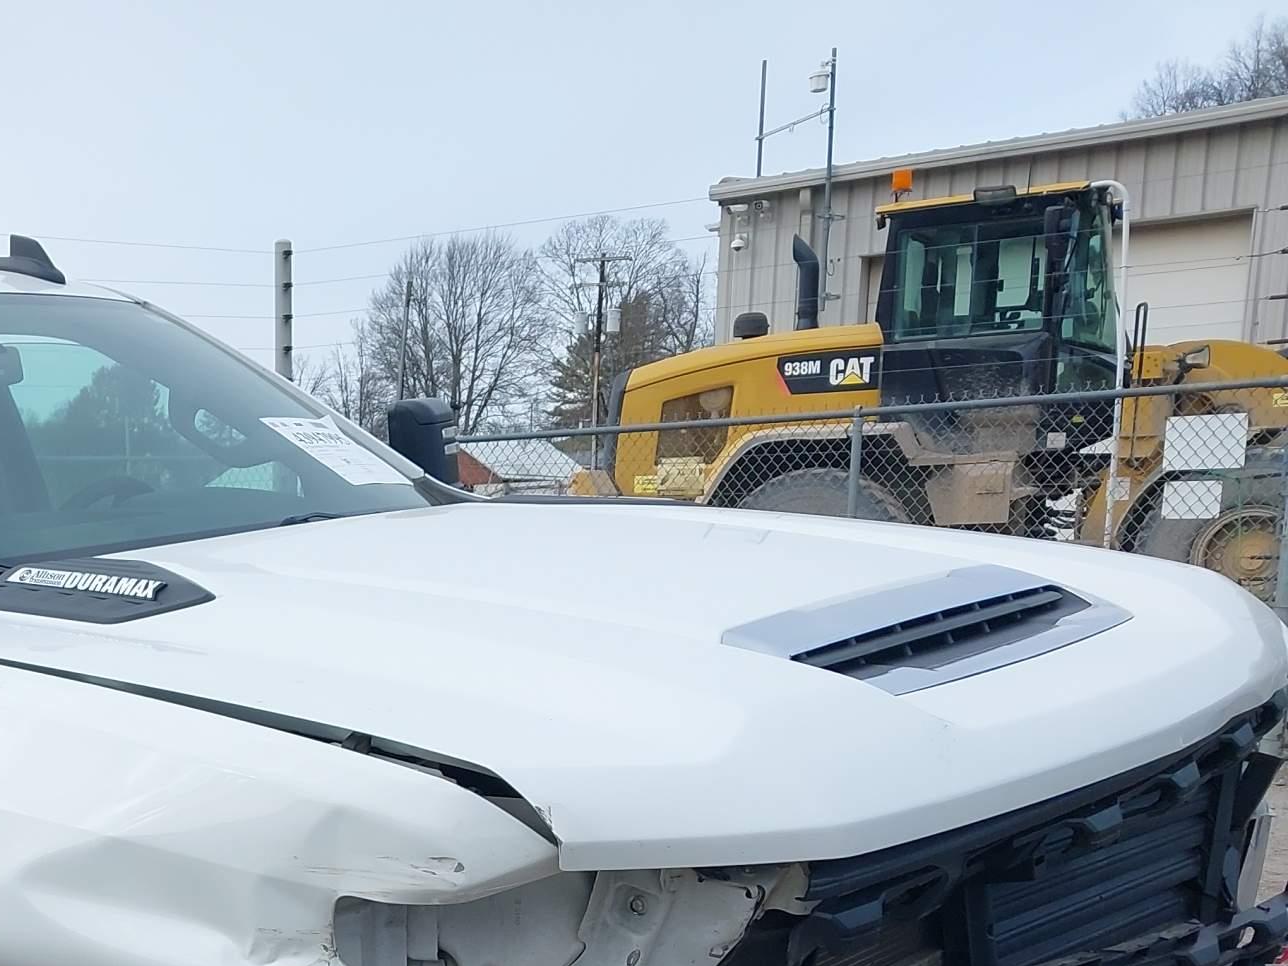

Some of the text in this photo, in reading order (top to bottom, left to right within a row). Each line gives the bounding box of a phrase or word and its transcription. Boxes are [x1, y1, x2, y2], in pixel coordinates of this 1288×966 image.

[784, 360, 821, 376] 938M
[829, 356, 875, 386] CAT
[31, 570, 66, 581] Allison
[64, 571, 164, 599] DURAMAX
